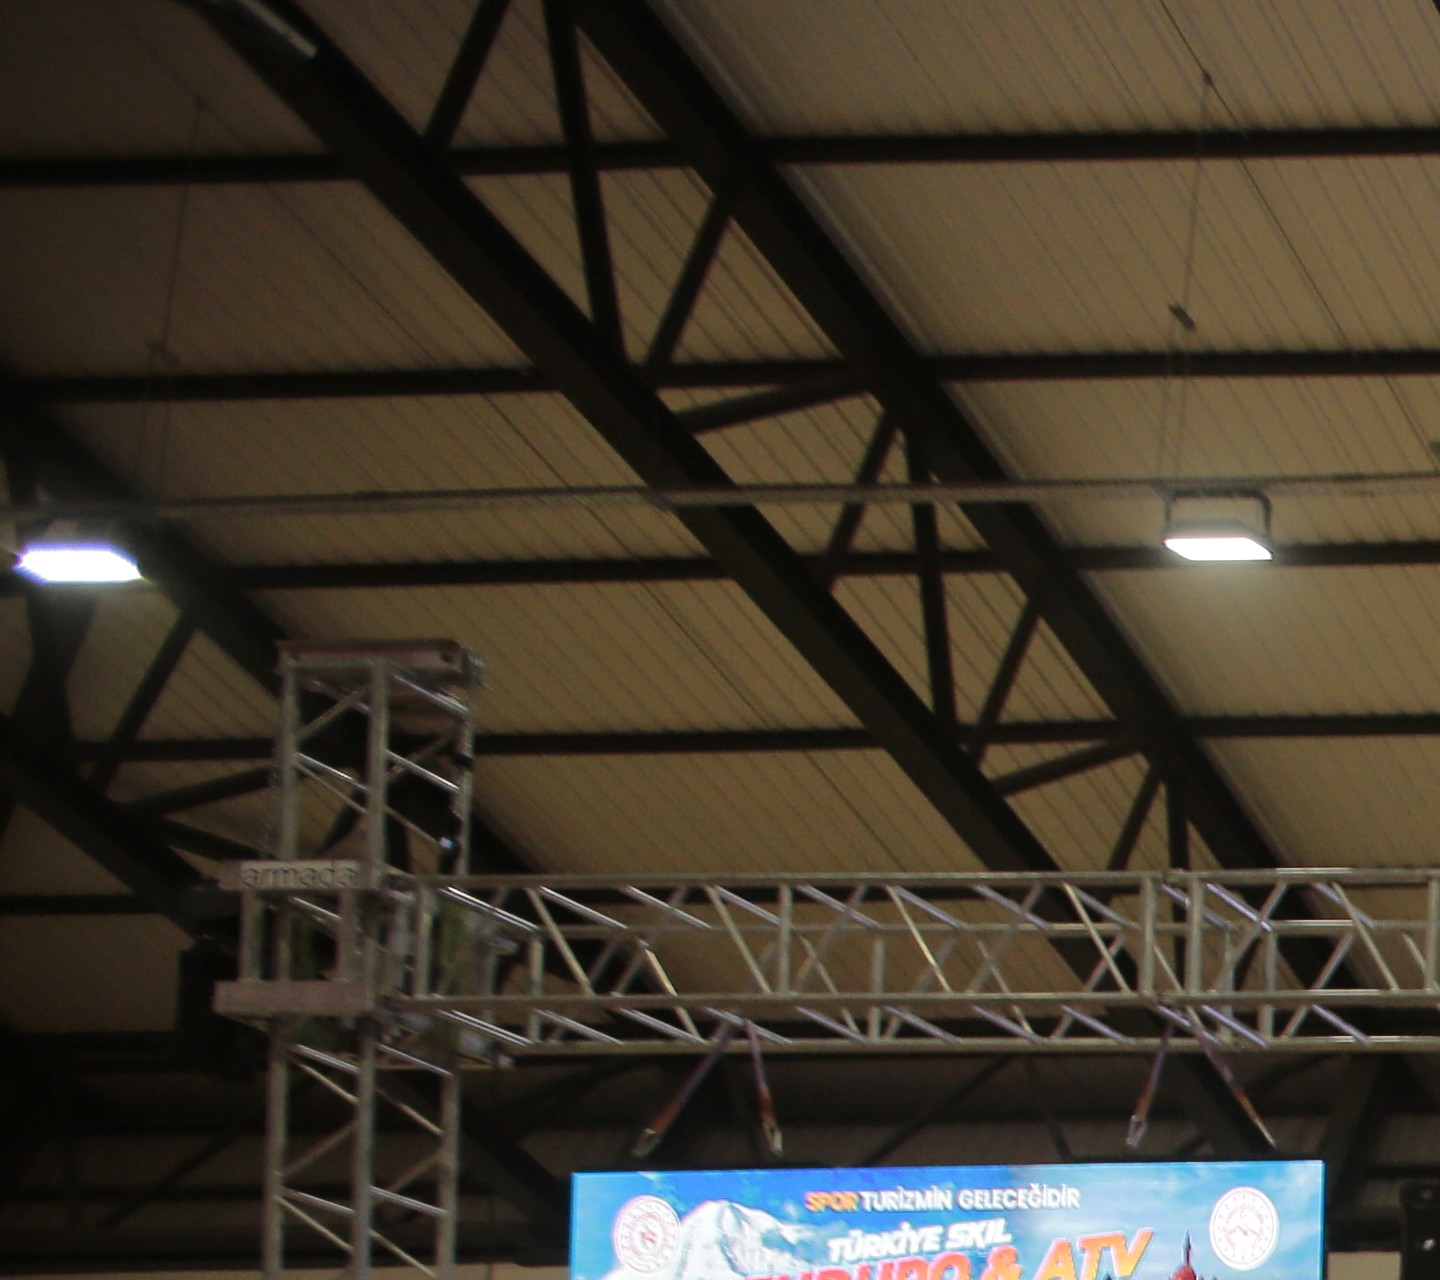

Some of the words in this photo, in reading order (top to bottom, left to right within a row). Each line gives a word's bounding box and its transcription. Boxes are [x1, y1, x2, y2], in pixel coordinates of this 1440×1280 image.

[805, 1191, 859, 1213] SPOR
[860, 1185, 952, 1212] TURİZMİN
[959, 1183, 1080, 1211] GELECEĞİDİR
[827, 1221, 945, 1262] TÜRKİYE
[947, 1218, 1013, 1251] SKIL
